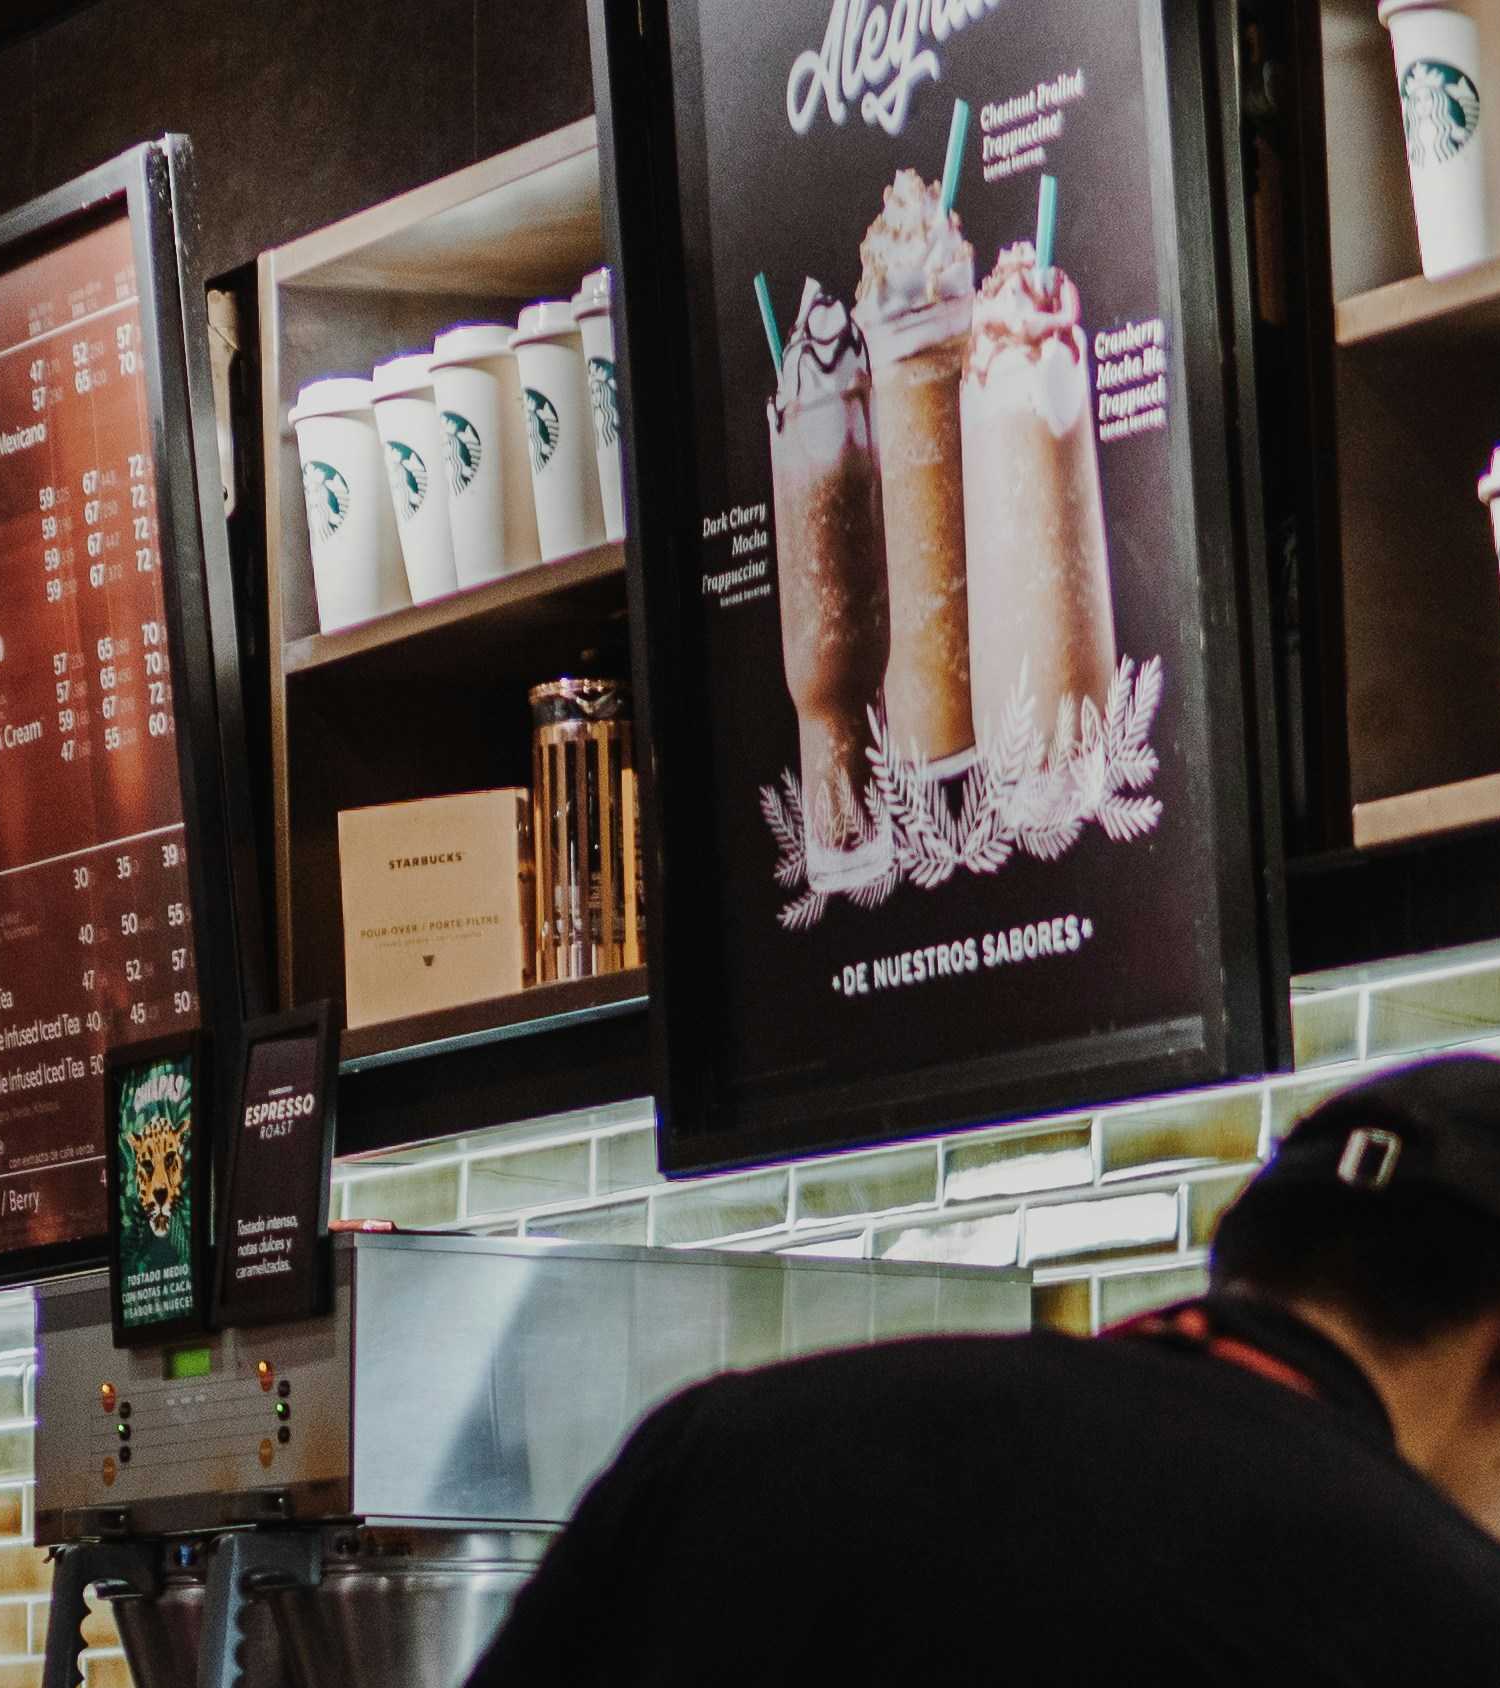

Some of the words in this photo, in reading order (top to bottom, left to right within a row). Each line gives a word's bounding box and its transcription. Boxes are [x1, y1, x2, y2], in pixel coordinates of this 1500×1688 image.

[981, 89, 1037, 131] Chestnut
[1036, 68, 1083, 111] Praliné
[1095, 320, 1164, 359] Cranberry
[1097, 354, 1143, 390] Mocha
[82, 469, 99, 495] 67
[127, 452, 146, 478] 72
[83, 499, 101, 525] 67
[130, 482, 148, 508] 72
[703, 511, 728, 538] Dark
[729, 503, 766, 529] Cherry
[86, 531, 103, 556] 67
[132, 515, 151, 540] 72
[732, 528, 767, 555] Mocha
[89, 563, 105, 587] 67
[135, 547, 154, 572] 72
[702, 558, 766, 594] Frappuccino
[52, 651, 68, 675] 57
[140, 620, 160, 646] 70
[143, 650, 163, 675] 70
[3, 721, 42, 749] Cream
[58, 708, 75, 732] 59
[101, 694, 118, 719] 67
[148, 680, 166, 705] 72
[60, 738, 76, 761] 47
[72, 866, 89, 890] 30
[389, 852, 462, 870] STARBUCKS
[78, 922, 94, 945] 40
[120, 911, 139, 935] 50
[81, 968, 96, 991] 47
[125, 958, 142, 982] 52
[171, 947, 187, 971] 57
[843, 963, 869, 997] DE
[873, 938, 979, 988] NUESTROS
[982, 914, 1080, 967] SABORES
[3, 1020, 39, 1048] Infused
[38, 1016, 63, 1041] Iced
[61, 1012, 81, 1035] Tea
[129, 1001, 147, 1024] 45
[173, 990, 191, 1014] 50
[7, 1063, 43, 1091] Infused
[42, 1058, 66, 1084] Iced
[64, 1055, 86, 1078] Tea
[245, 1093, 315, 1127] ESPRESSO
[260, 1120, 294, 1139] ROAST
[8, 1189, 40, 1213] Berry
[237, 1218, 265, 1236] Tostado
[238, 1243, 258, 1257] notas
[259, 1234, 285, 1254] dulces
[128, 1270, 161, 1288] TOSTADO
[163, 1264, 189, 1279] MEDIO
[138, 1286, 161, 1301] NOTAS
[163, 1285, 169, 1296] A
[169, 1280, 192, 1294] CACA
